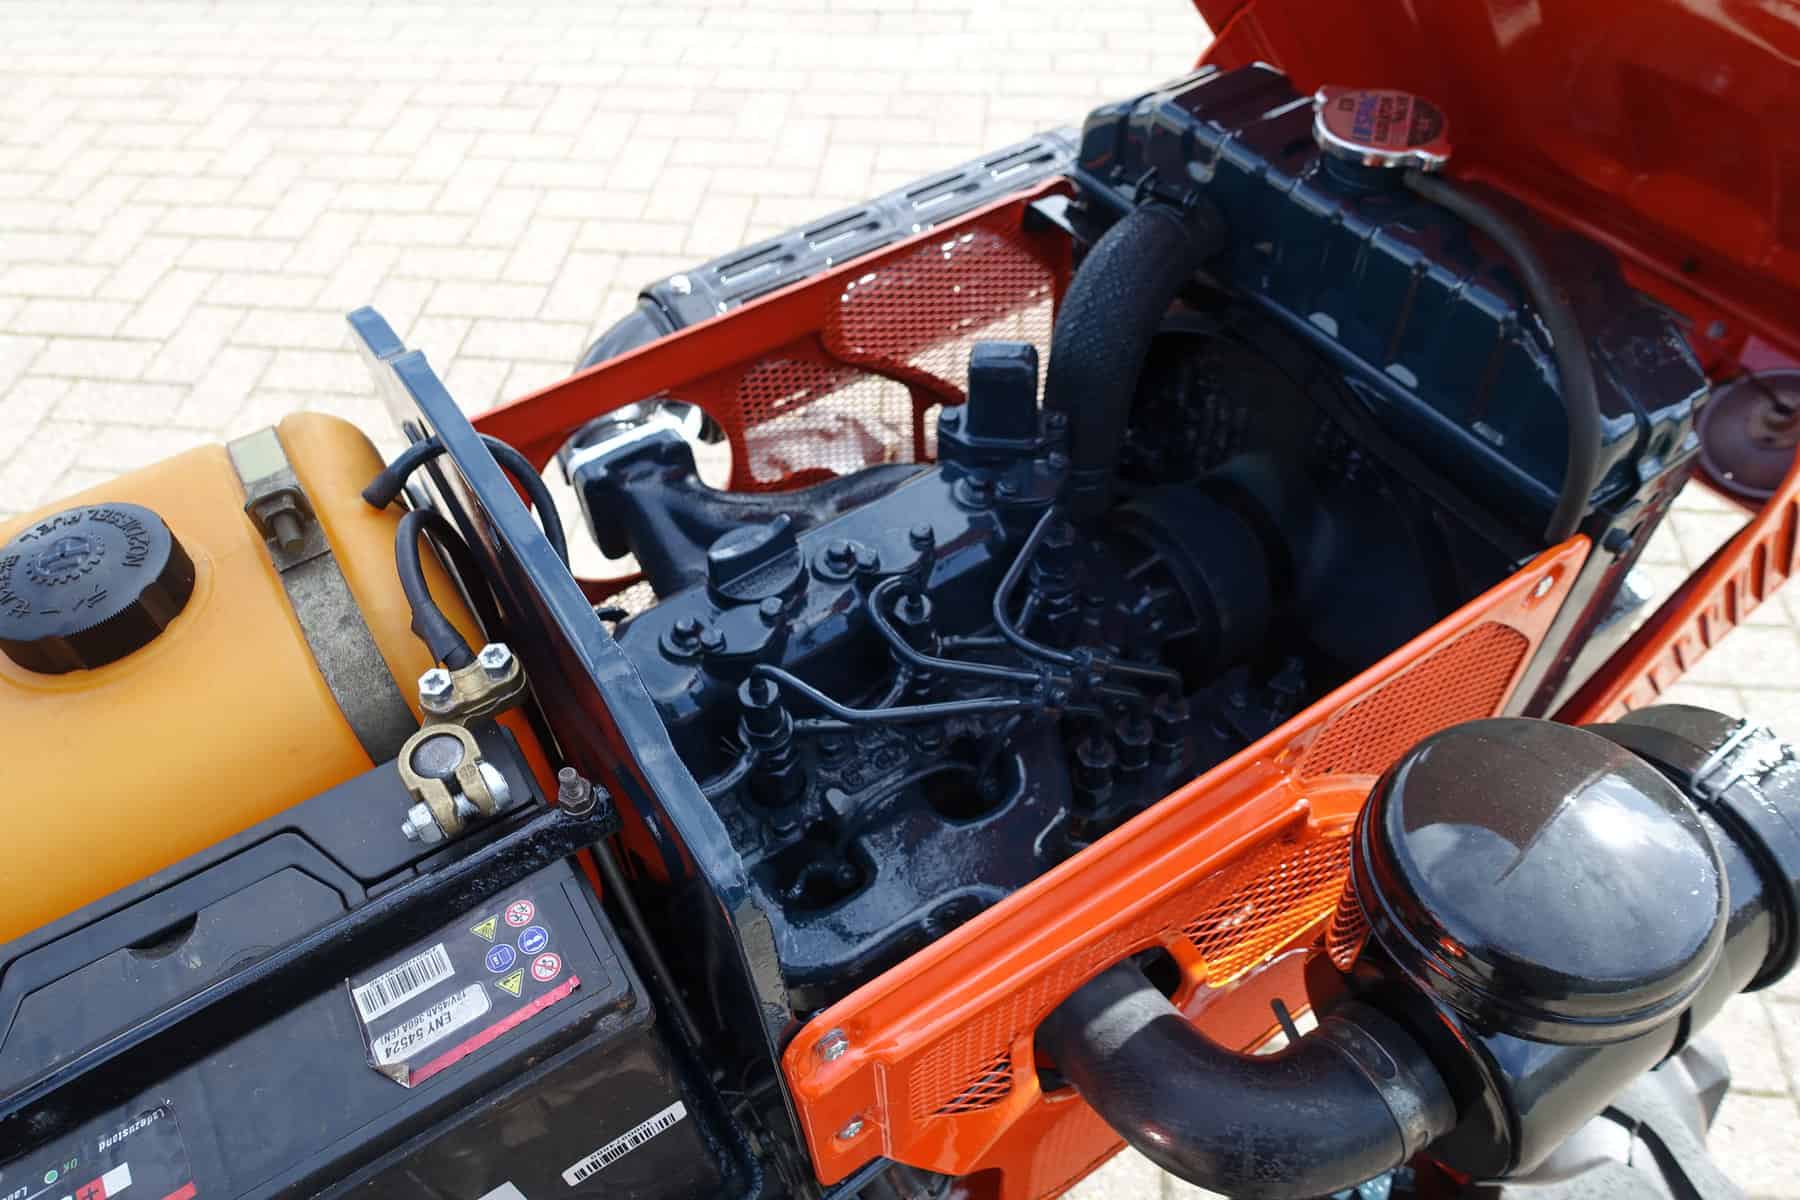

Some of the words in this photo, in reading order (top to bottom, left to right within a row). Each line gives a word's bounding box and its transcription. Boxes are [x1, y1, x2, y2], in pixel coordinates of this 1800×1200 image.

[427, 1011, 452, 1034] ENY
[385, 1028, 424, 1058] 54524
[98, 1107, 165, 1153] Ladezustand
